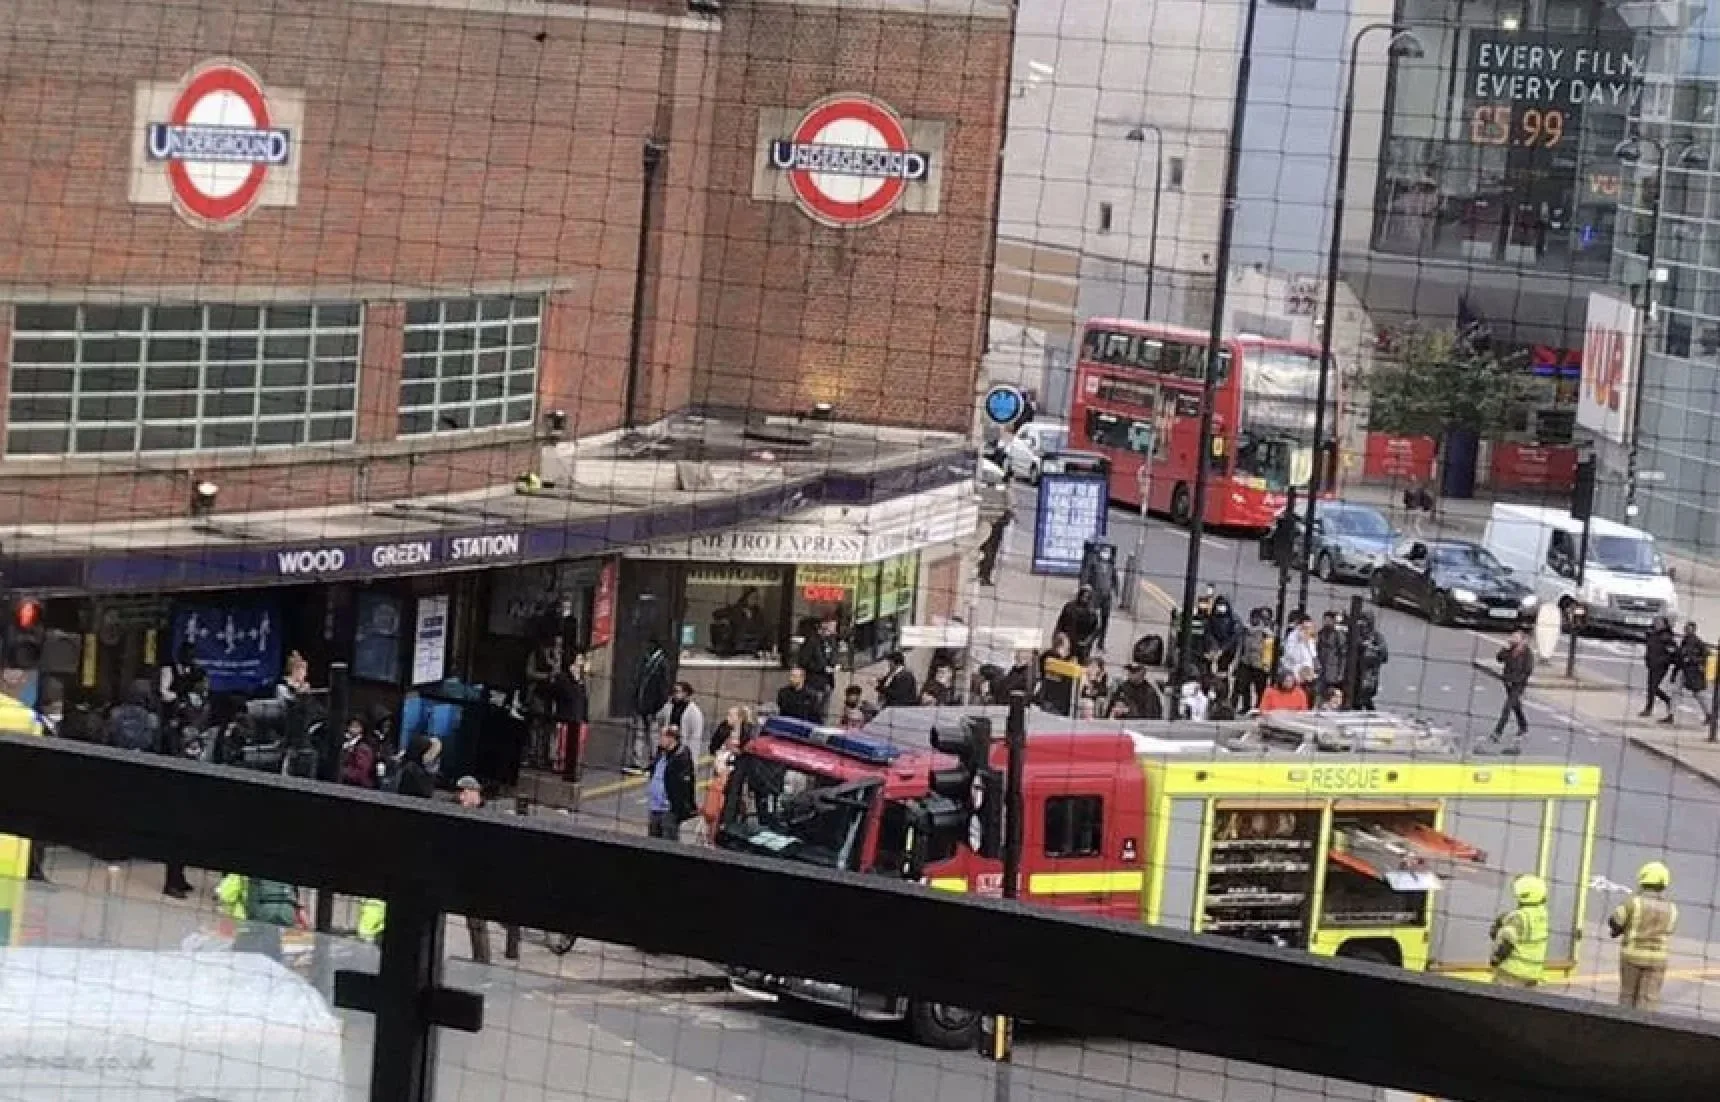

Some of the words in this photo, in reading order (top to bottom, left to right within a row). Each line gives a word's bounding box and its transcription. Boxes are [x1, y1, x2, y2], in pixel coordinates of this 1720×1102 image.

[1479, 43, 1564, 71] EVERY
[1475, 73, 1561, 101] EVERY
[1570, 79, 1625, 105] DAY
[1470, 105, 1564, 148] £5.99
[152, 125, 287, 161] UNDERGROUND
[277, 548, 345, 574] WOOD
[371, 541, 431, 569] GREEN
[451, 533, 519, 560] STATION
[698, 532, 771, 551] METRO
[775, 534, 861, 553] EXPRESS
[1311, 767, 1380, 789] RESCUE
